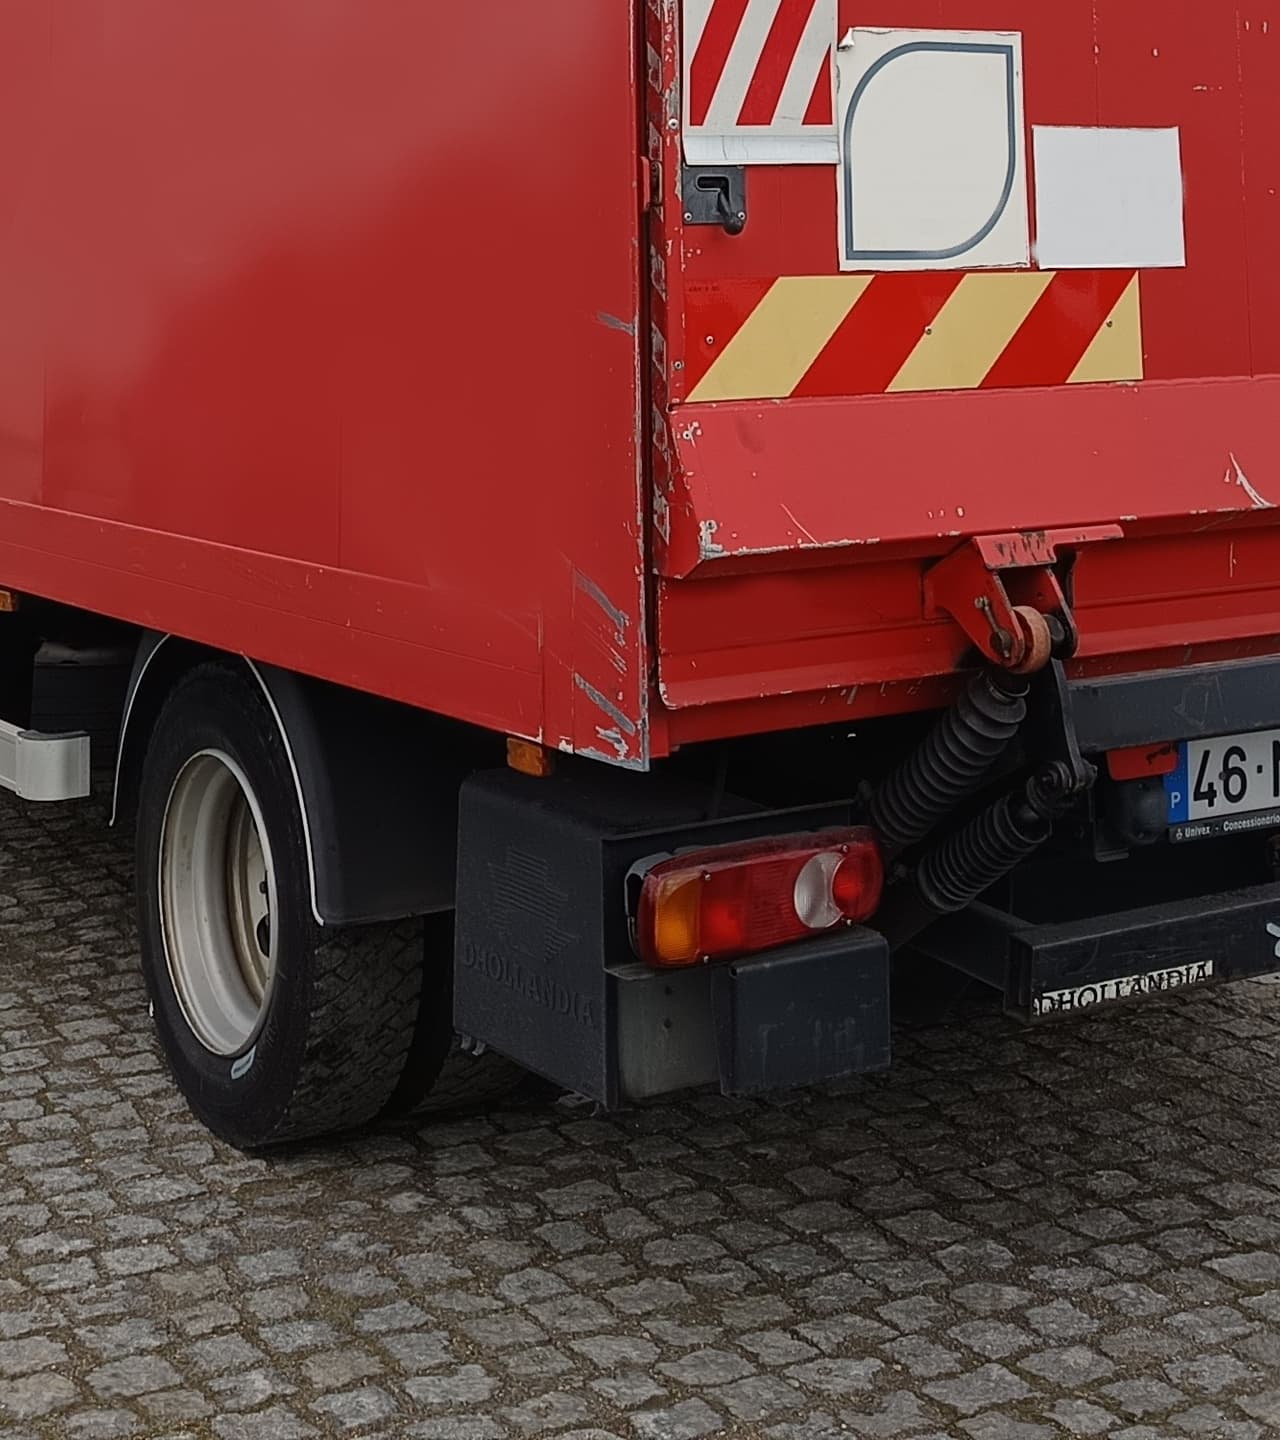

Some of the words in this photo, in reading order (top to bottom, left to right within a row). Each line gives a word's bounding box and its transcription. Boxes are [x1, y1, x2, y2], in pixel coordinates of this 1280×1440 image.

[1170, 791, 1181, 809] P
[1184, 825, 1211, 838] Univex
[461, 941, 594, 1026] DHOLLANDIA
